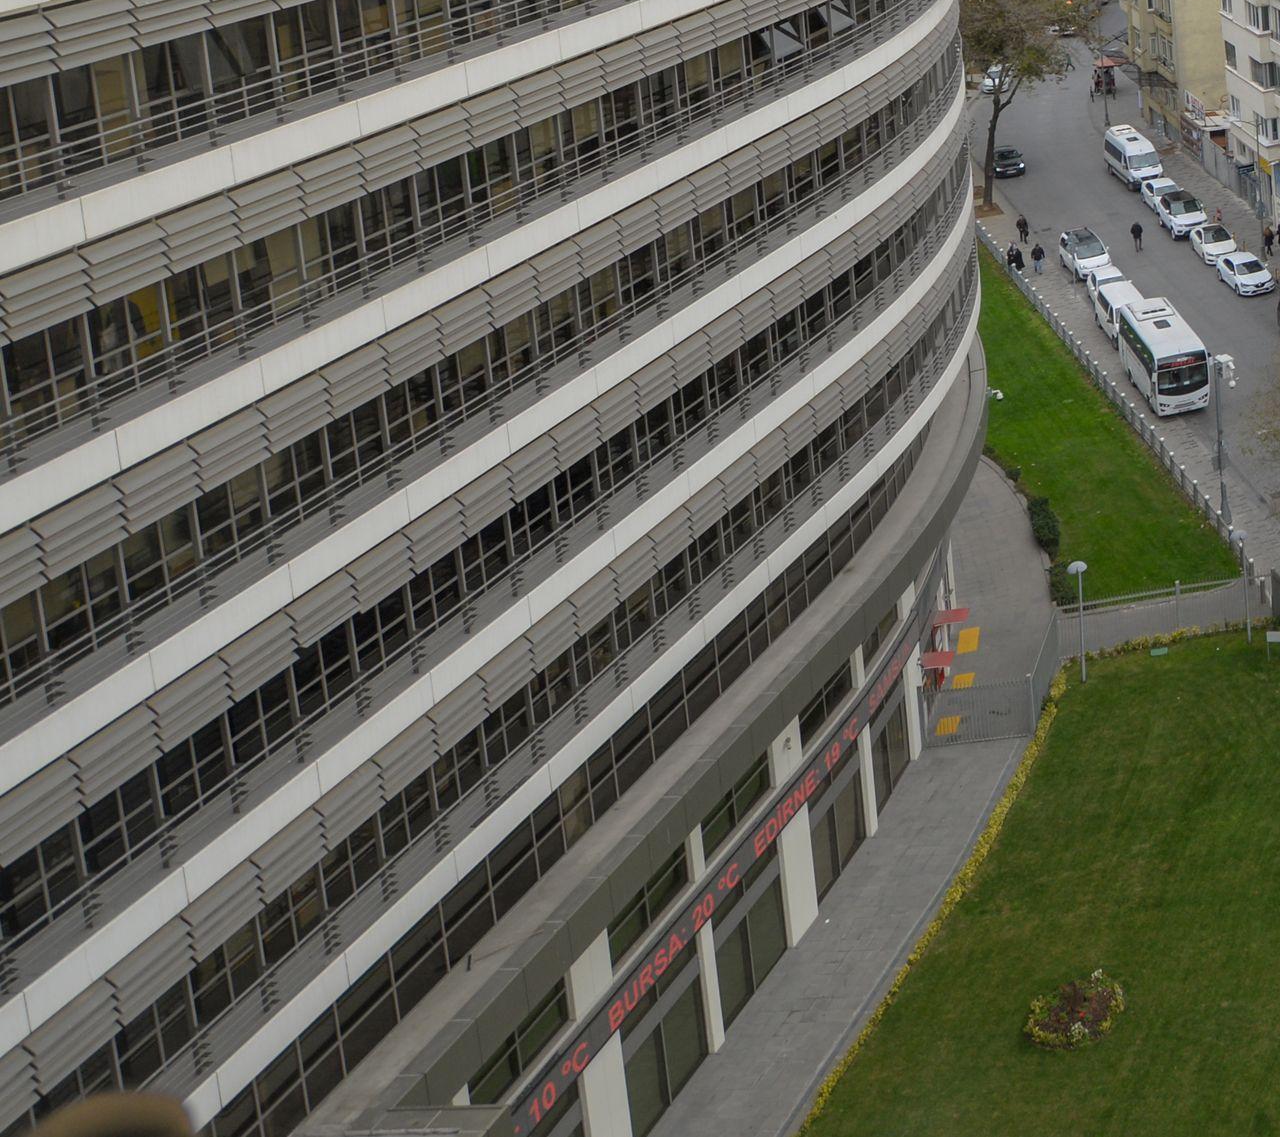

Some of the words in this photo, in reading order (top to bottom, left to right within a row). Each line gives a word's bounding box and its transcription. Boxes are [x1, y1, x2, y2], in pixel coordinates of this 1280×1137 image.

[529, 1081, 556, 1125] 10
[607, 926, 689, 1032] BURSA:
[692, 893, 715, 931] 20
[753, 766, 821, 858] EDİRNE:
[824, 741, 841, 770] 19
